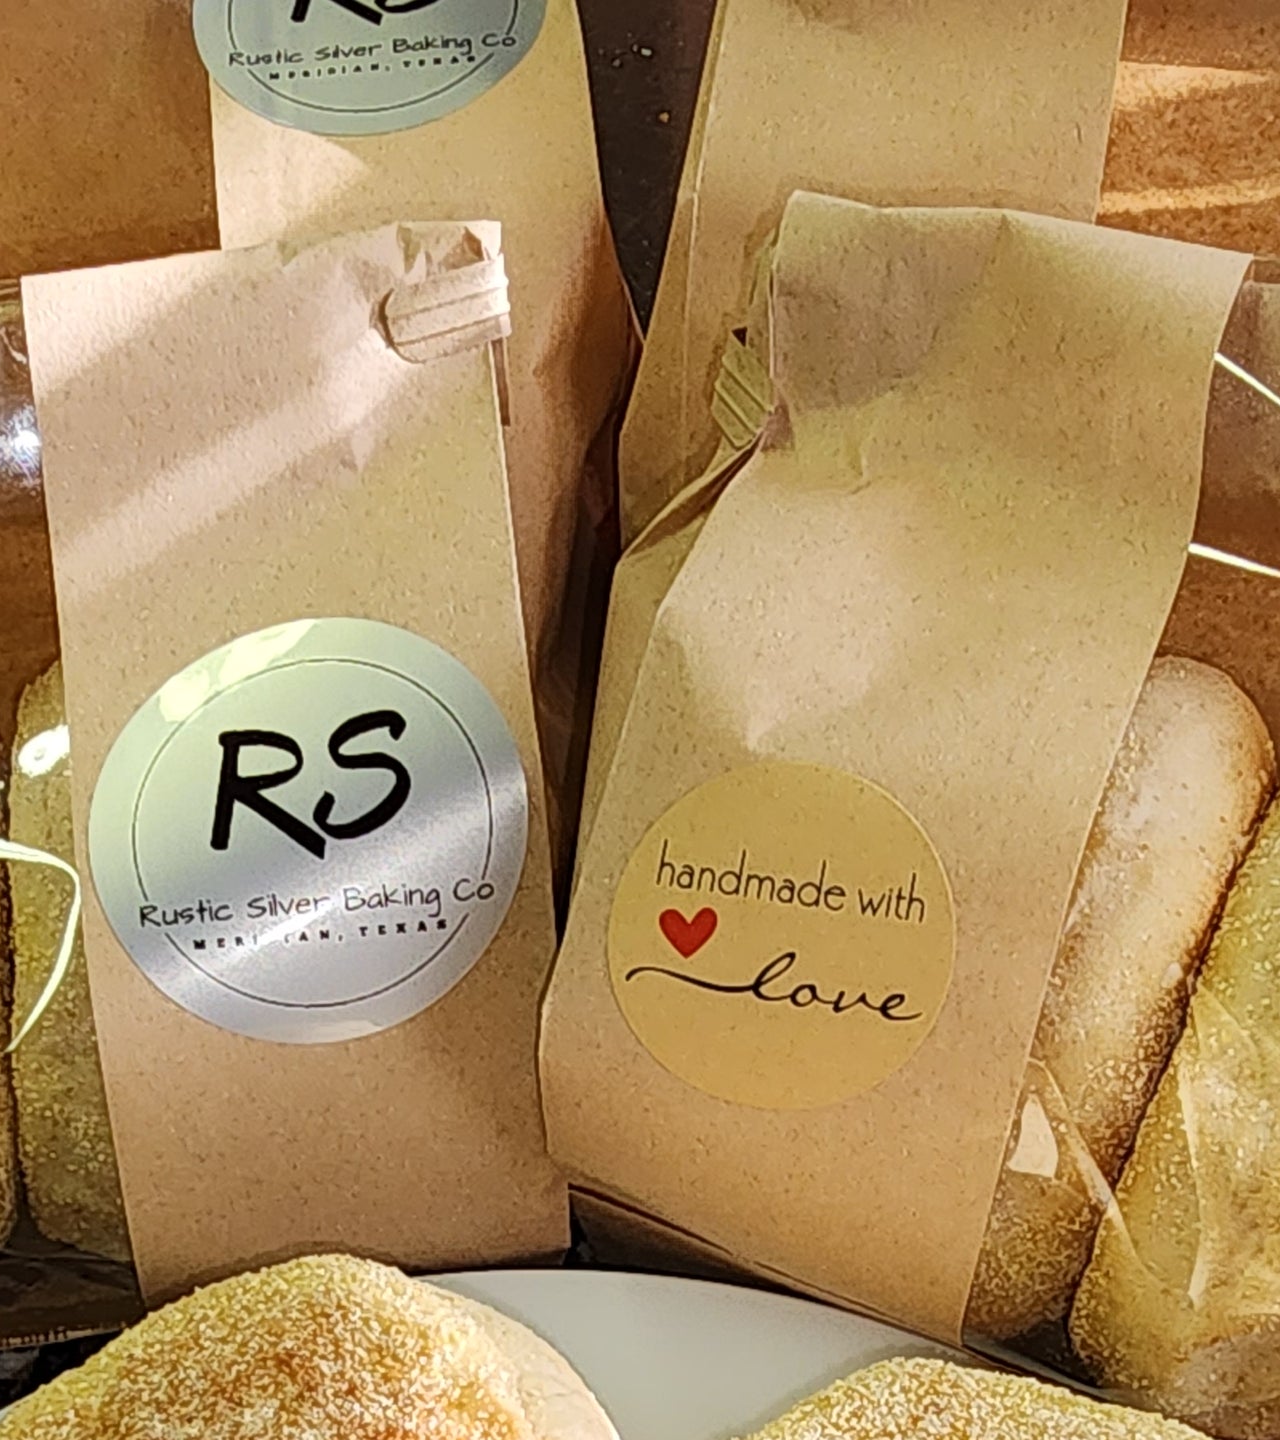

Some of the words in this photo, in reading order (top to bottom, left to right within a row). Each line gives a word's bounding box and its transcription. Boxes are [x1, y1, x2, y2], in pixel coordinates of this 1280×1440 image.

[229, 50, 304, 67] Rustic
[314, 43, 382, 61] Silver
[392, 35, 473, 56] Baking
[481, 33, 517, 47] Co
[210, 709, 412, 860] RS
[140, 899, 234, 928] Rustic
[246, 893, 333, 918] Silver
[343, 884, 442, 918] Baking
[452, 878, 495, 901] Co
[656, 838, 846, 911] handmade
[857, 872, 926, 923] with
[360, 919, 447, 936] TEXAS
[625, 951, 923, 1021] love
